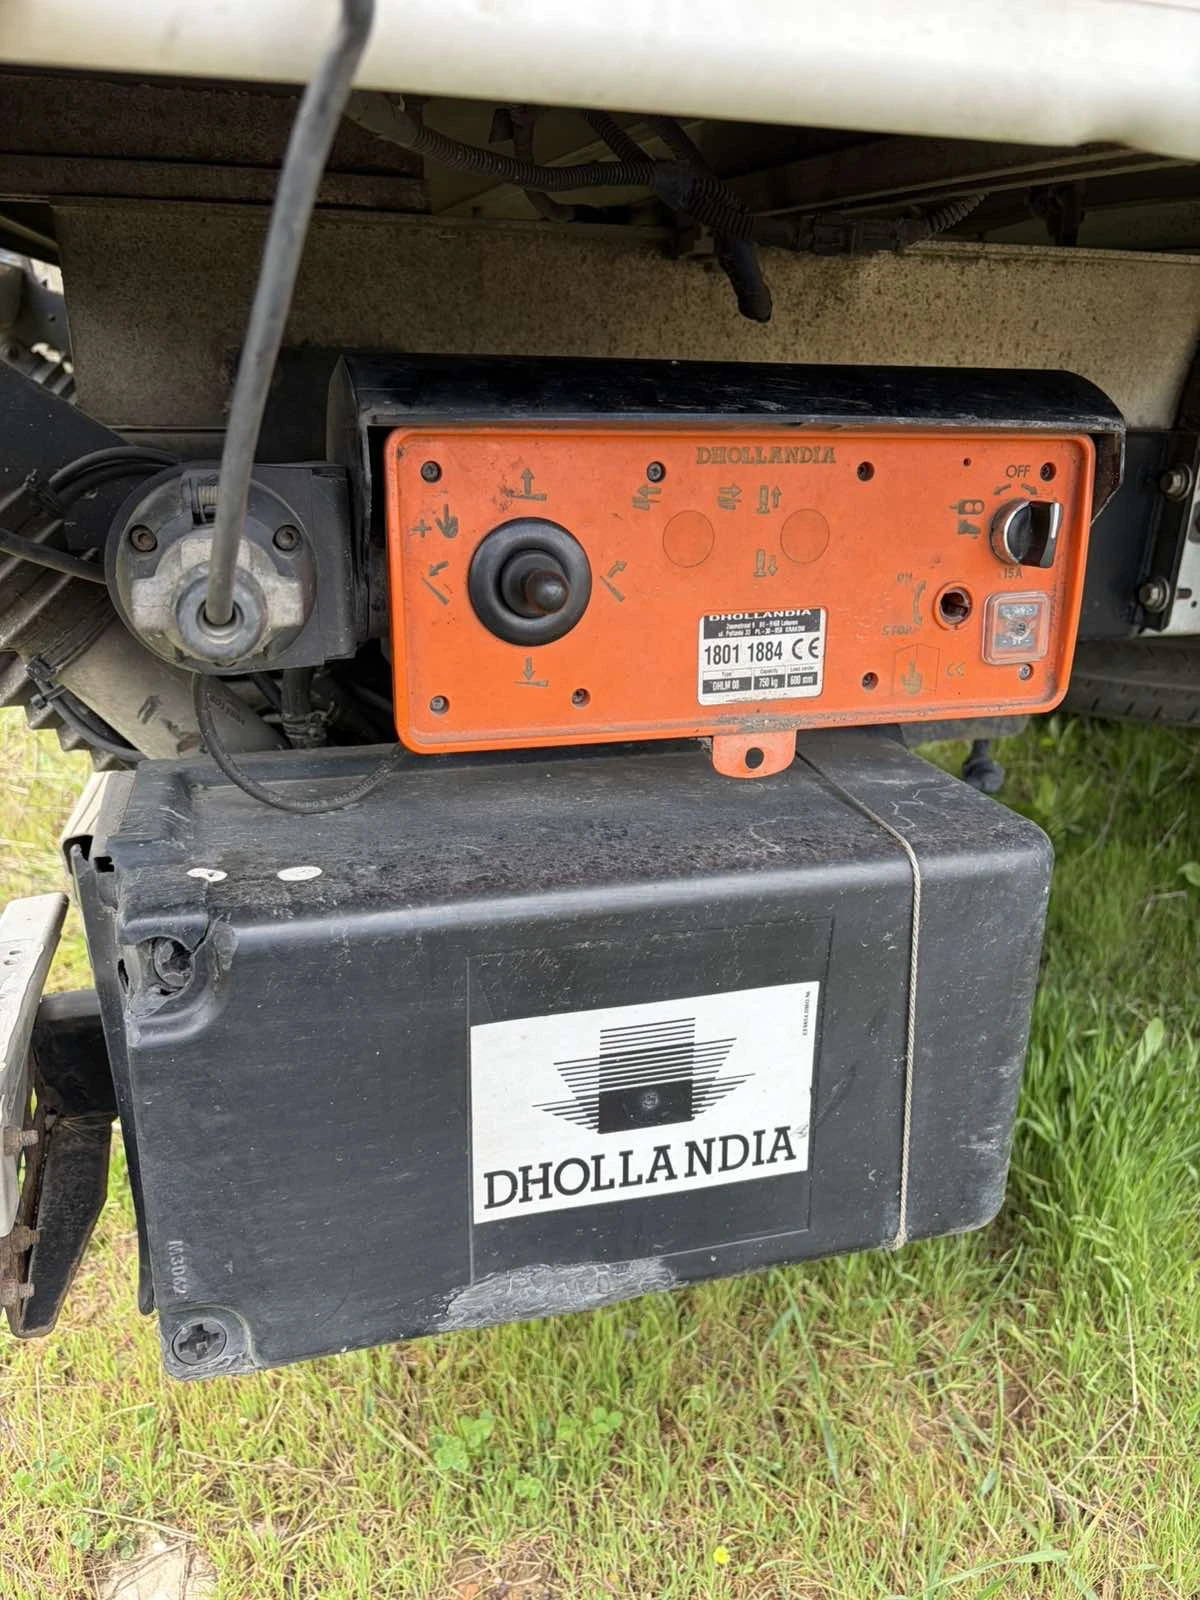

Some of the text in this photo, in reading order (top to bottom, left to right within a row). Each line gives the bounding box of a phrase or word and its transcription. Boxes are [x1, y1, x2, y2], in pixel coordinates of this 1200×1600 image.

[696, 446, 837, 464] DHOLLANDIA
[1005, 464, 1031, 478] OFF
[708, 609, 812, 622] DHOLLANDIA
[704, 643, 740, 665] 1801
[747, 640, 783, 663] 1884
[759, 677, 778, 688] 750 kg
[802, 676, 814, 684] mm
[483, 1125, 797, 1210] DHOLLANDIA
